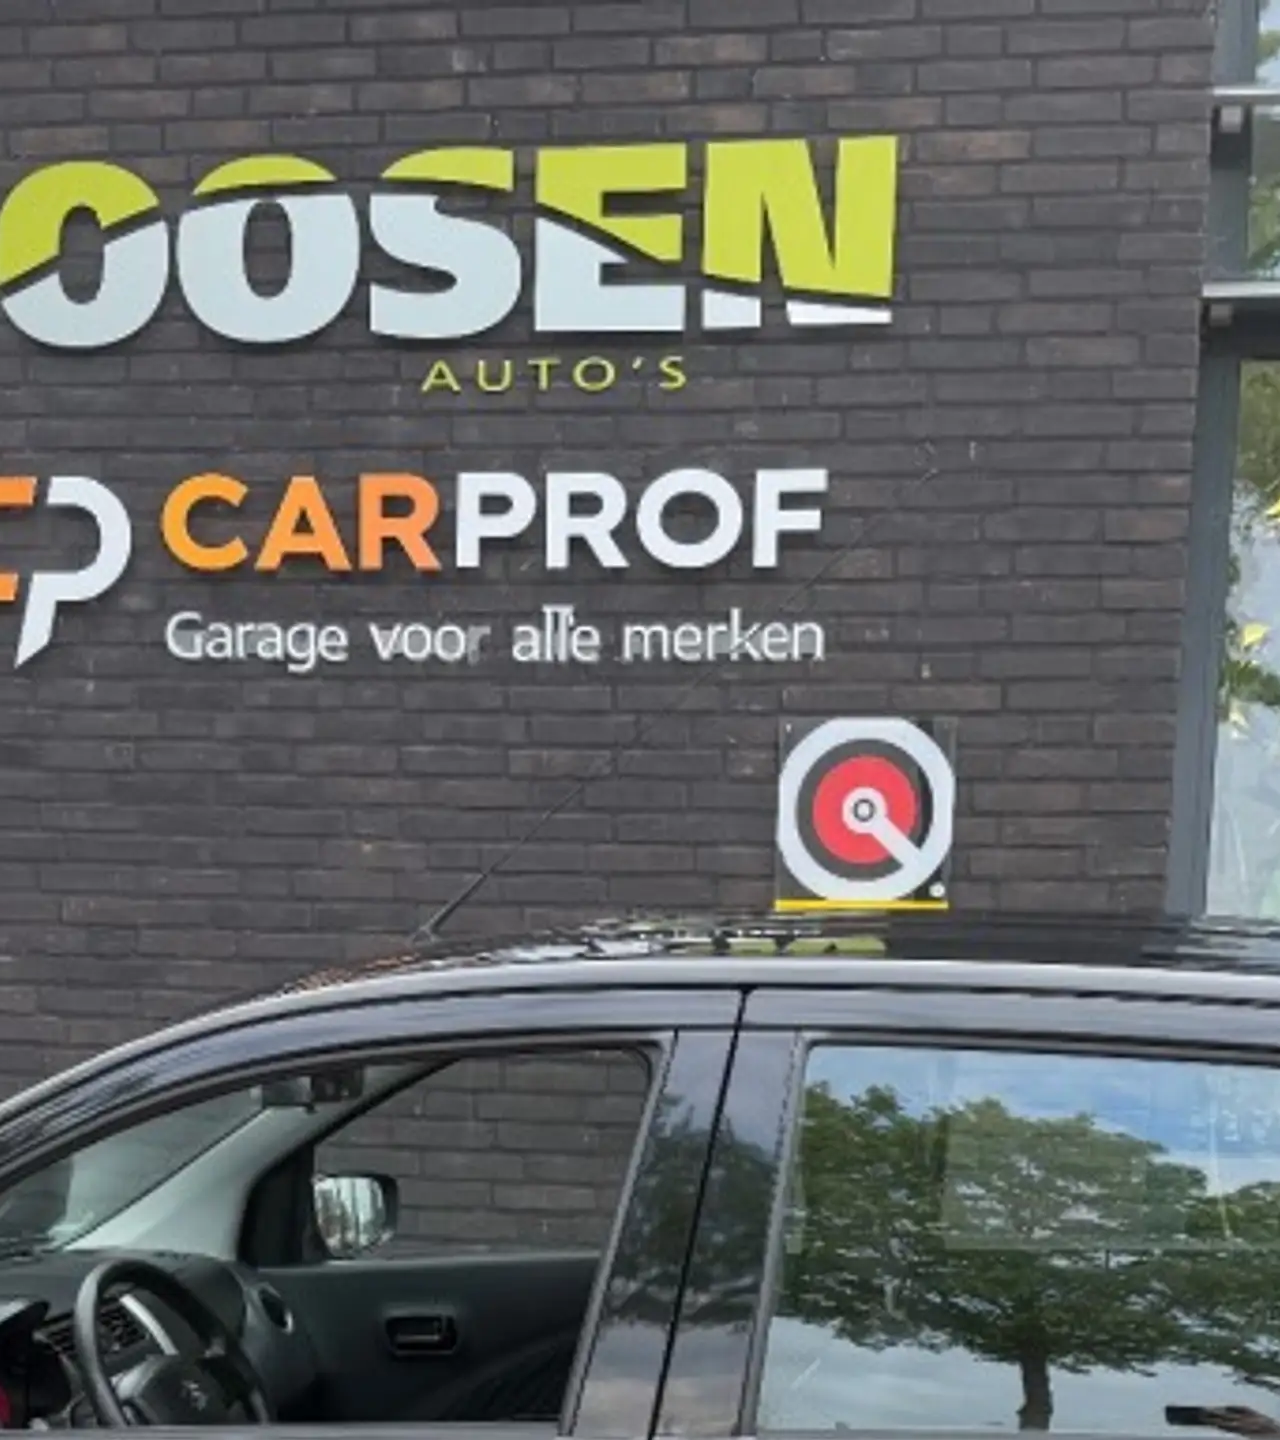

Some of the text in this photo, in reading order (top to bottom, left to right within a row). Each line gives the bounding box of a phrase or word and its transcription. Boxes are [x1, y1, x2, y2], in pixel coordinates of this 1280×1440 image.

[421, 356, 687, 392] AUTO'S
[160, 467, 829, 571] CARPROF
[166, 604, 826, 672] Garage voor alle merken
